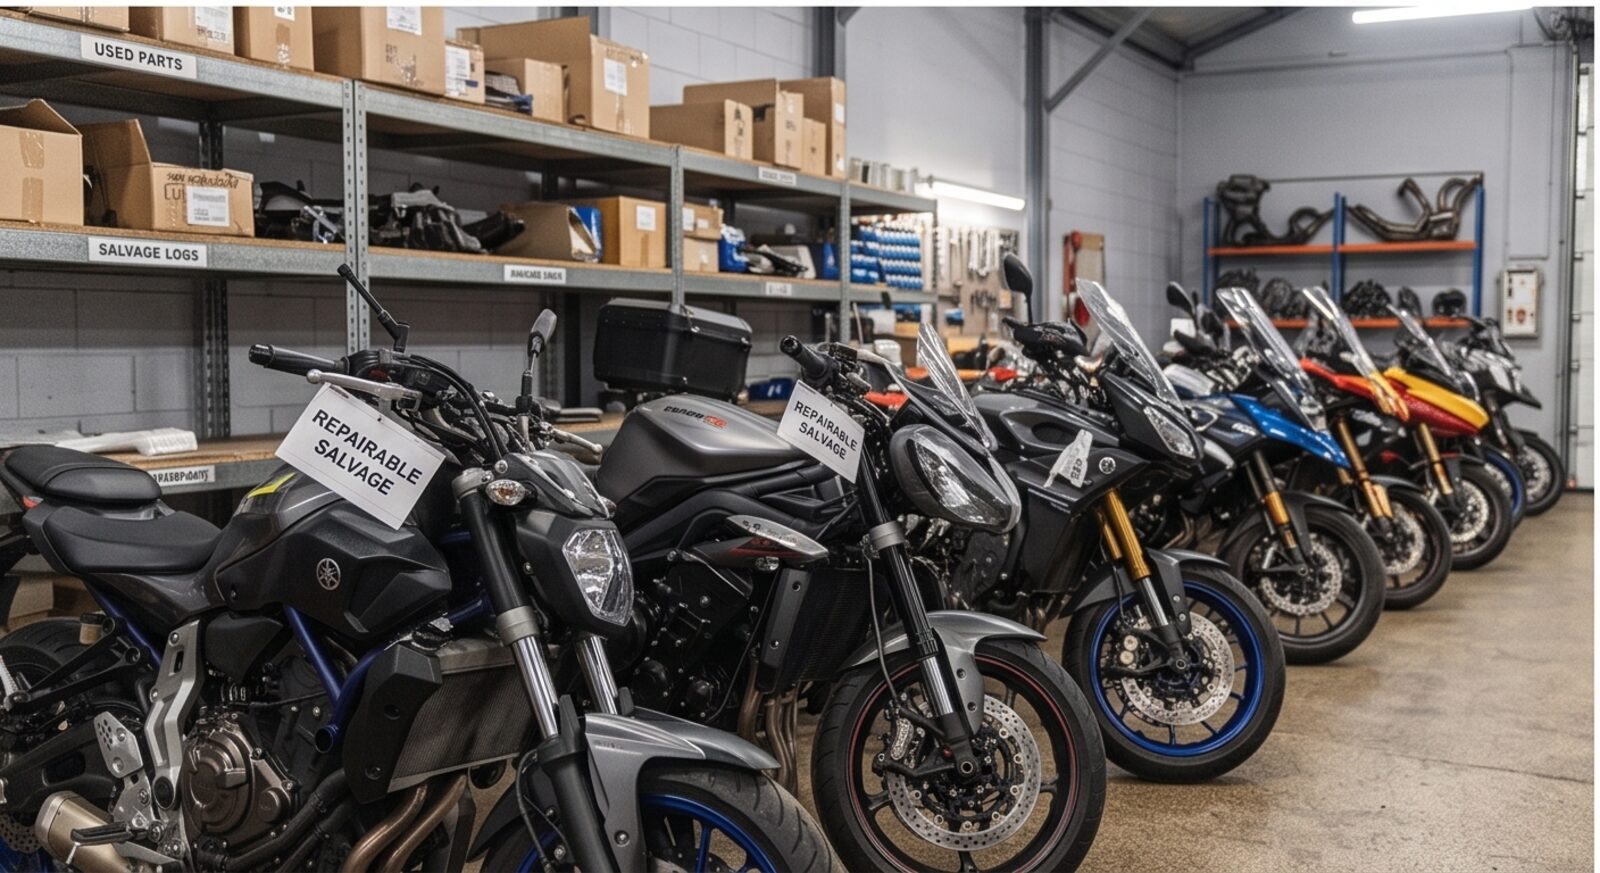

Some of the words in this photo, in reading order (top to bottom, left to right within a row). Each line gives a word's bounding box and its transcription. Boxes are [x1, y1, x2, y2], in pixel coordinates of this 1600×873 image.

[94, 42, 134, 61] USED
[139, 51, 183, 70] PARTS
[98, 243, 161, 259] SALVAGE
[165, 248, 199, 261] LOGS
[312, 409, 423, 485] REPAIRABLE
[794, 400, 858, 452] REPAIRABLE
[799, 422, 847, 460] SALVAGE
[314, 439, 395, 495] SALVAGE
